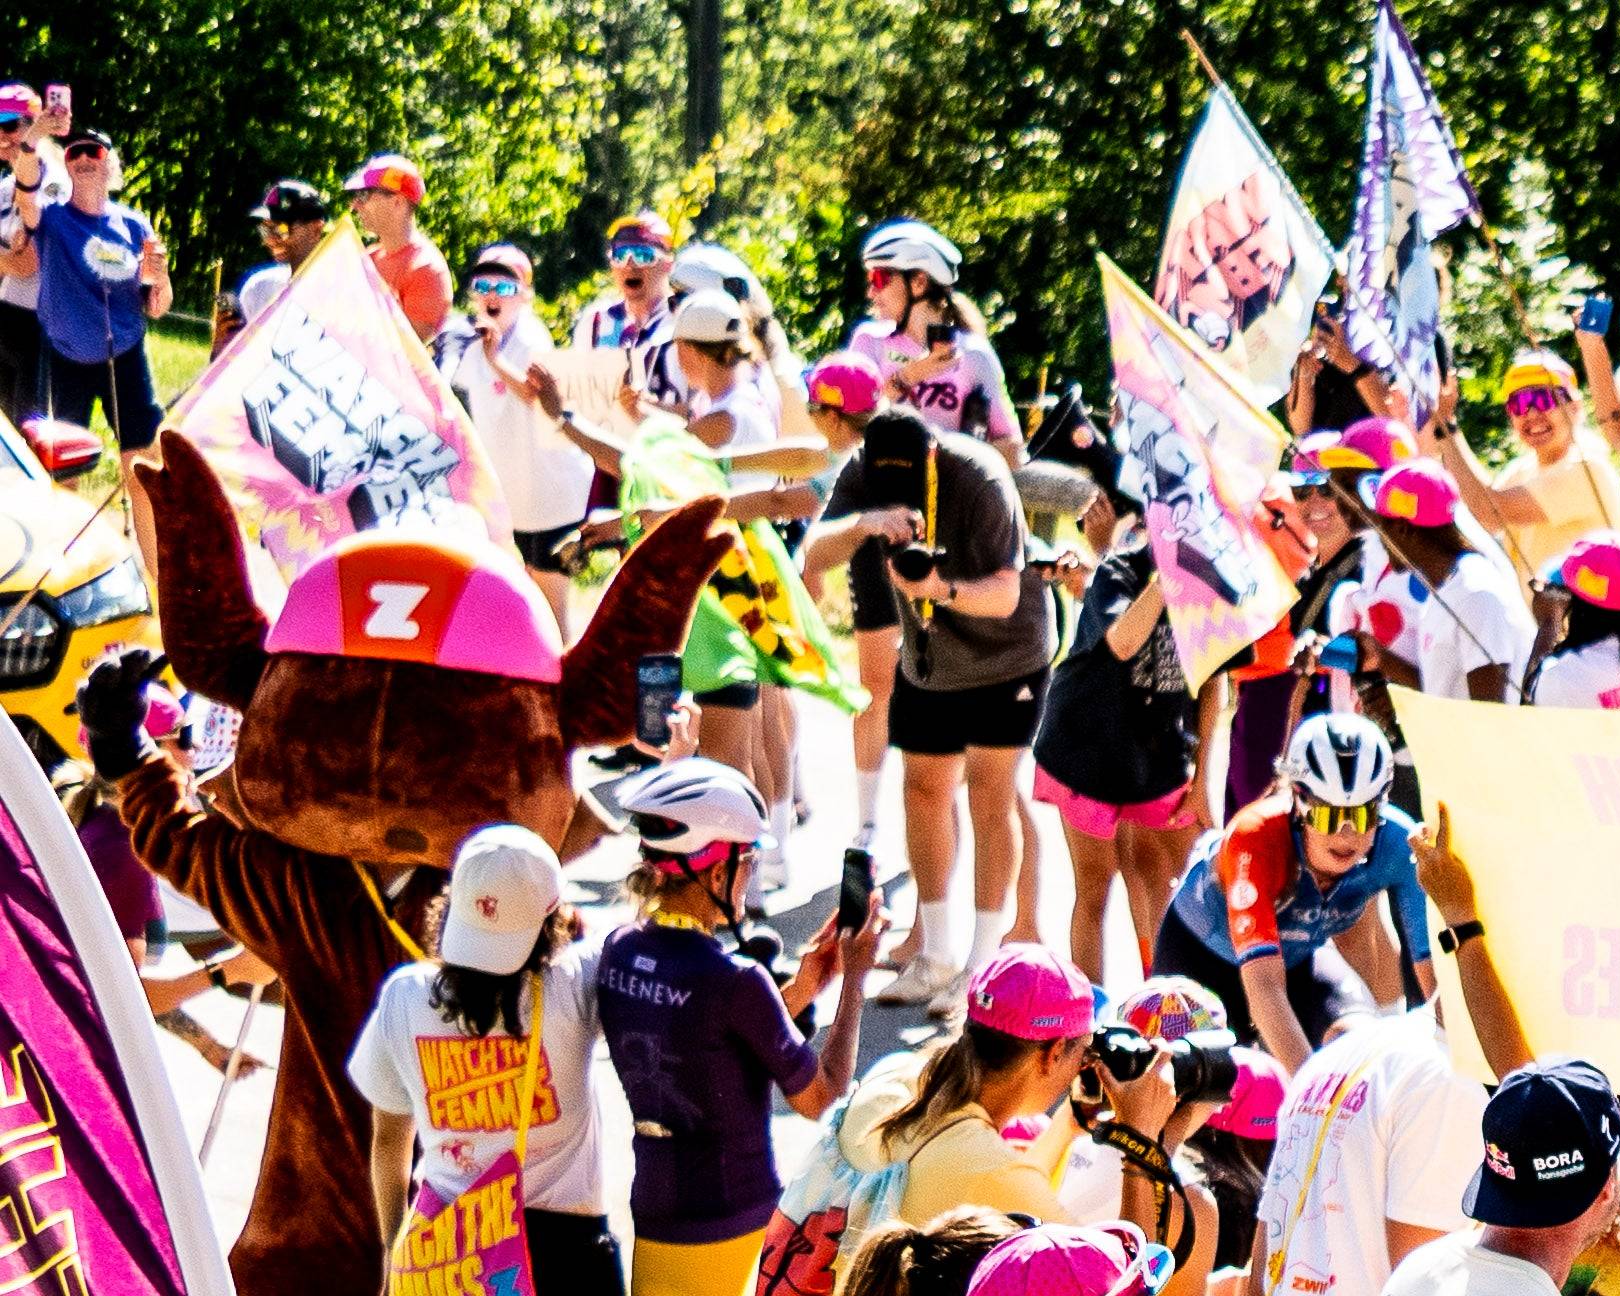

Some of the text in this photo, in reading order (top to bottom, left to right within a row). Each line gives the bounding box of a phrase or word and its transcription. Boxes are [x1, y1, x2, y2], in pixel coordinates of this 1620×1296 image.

[364, 582, 430, 639] Z
[416, 1036, 548, 1091] WATCH TH
[431, 1074, 558, 1131] FEMMS
[1532, 1149, 1585, 1172] BORA
[456, 1171, 521, 1253] THE
